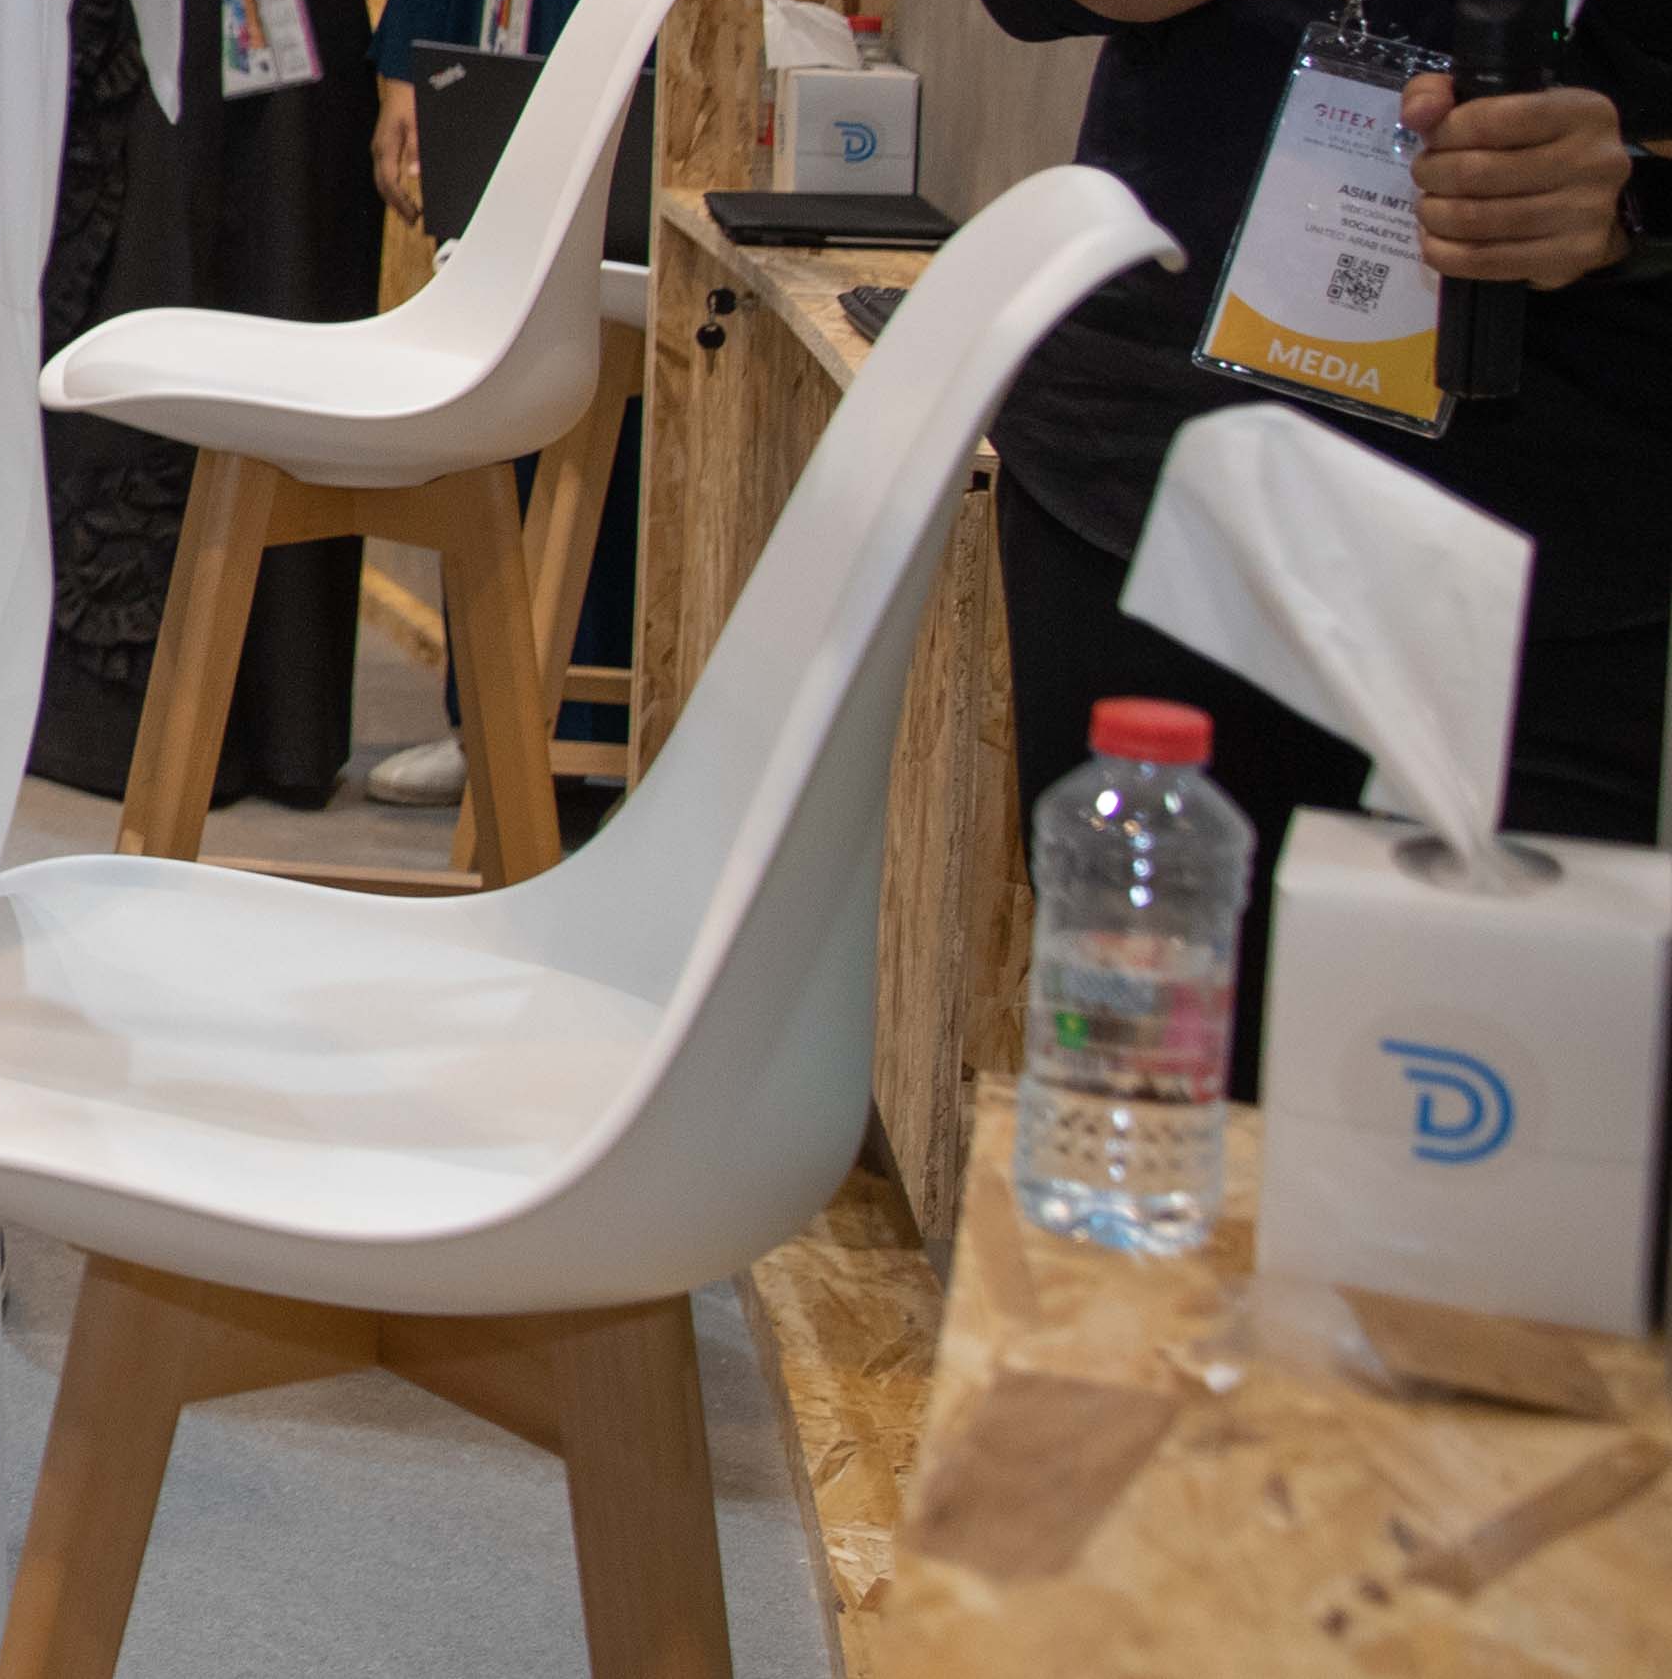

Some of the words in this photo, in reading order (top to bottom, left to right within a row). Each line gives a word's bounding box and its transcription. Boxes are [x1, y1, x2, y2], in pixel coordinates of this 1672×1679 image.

[1314, 103, 1376, 129] GITEX
[1338, 184, 1377, 202] ASIM
[1305, 222, 1346, 241] UNITED
[1266, 337, 1382, 395] MEDIA
